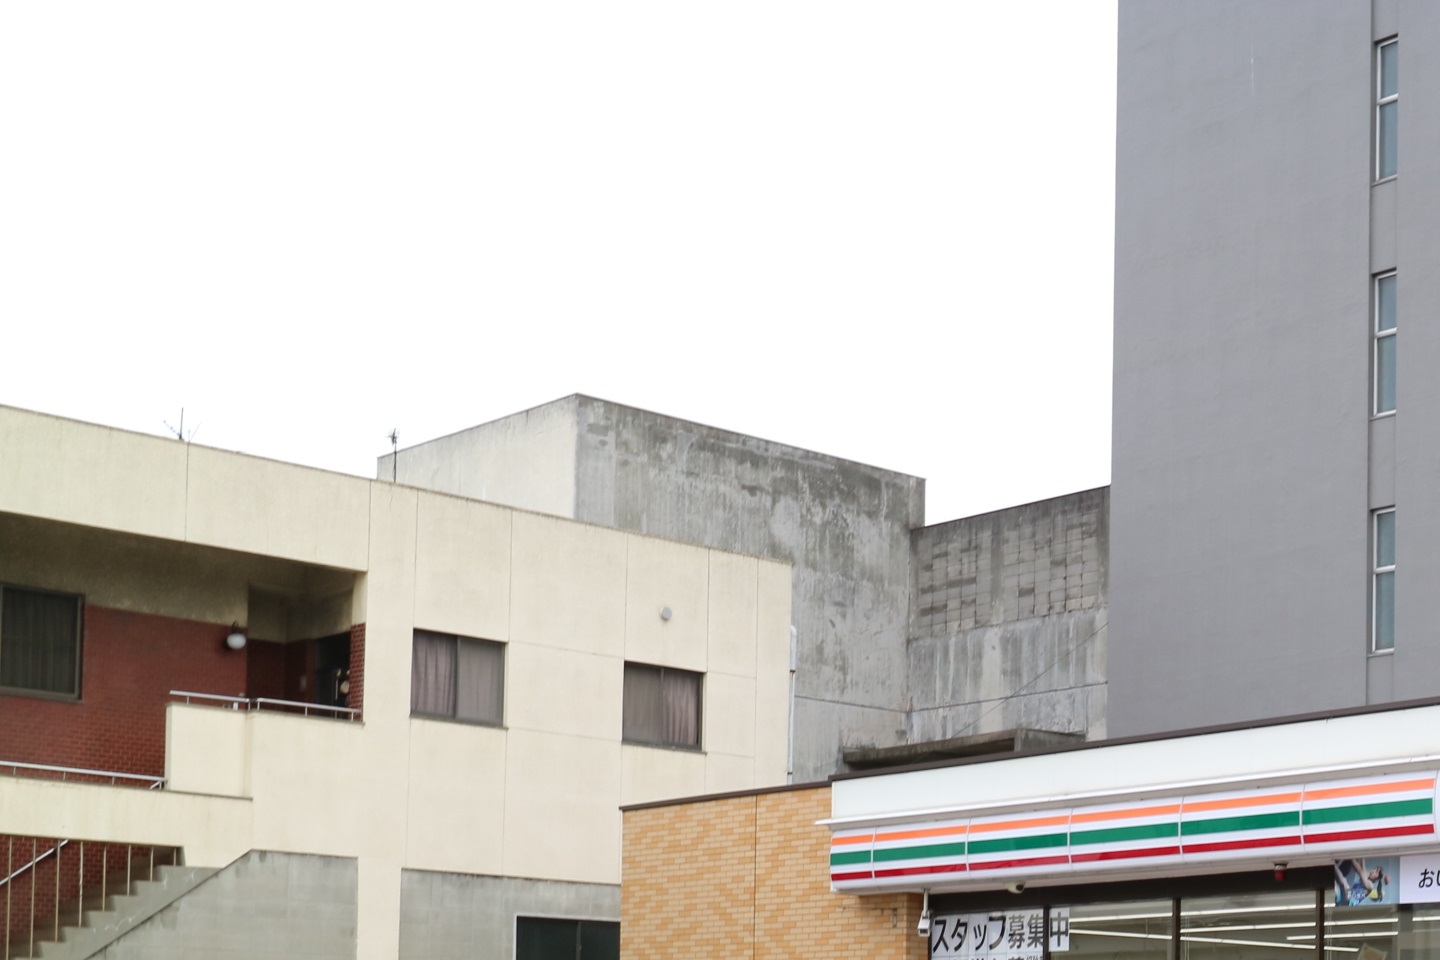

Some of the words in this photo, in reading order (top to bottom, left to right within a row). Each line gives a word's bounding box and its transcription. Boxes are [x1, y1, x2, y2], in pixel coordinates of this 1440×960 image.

[933, 911, 1069, 953] スタッフ募集中
